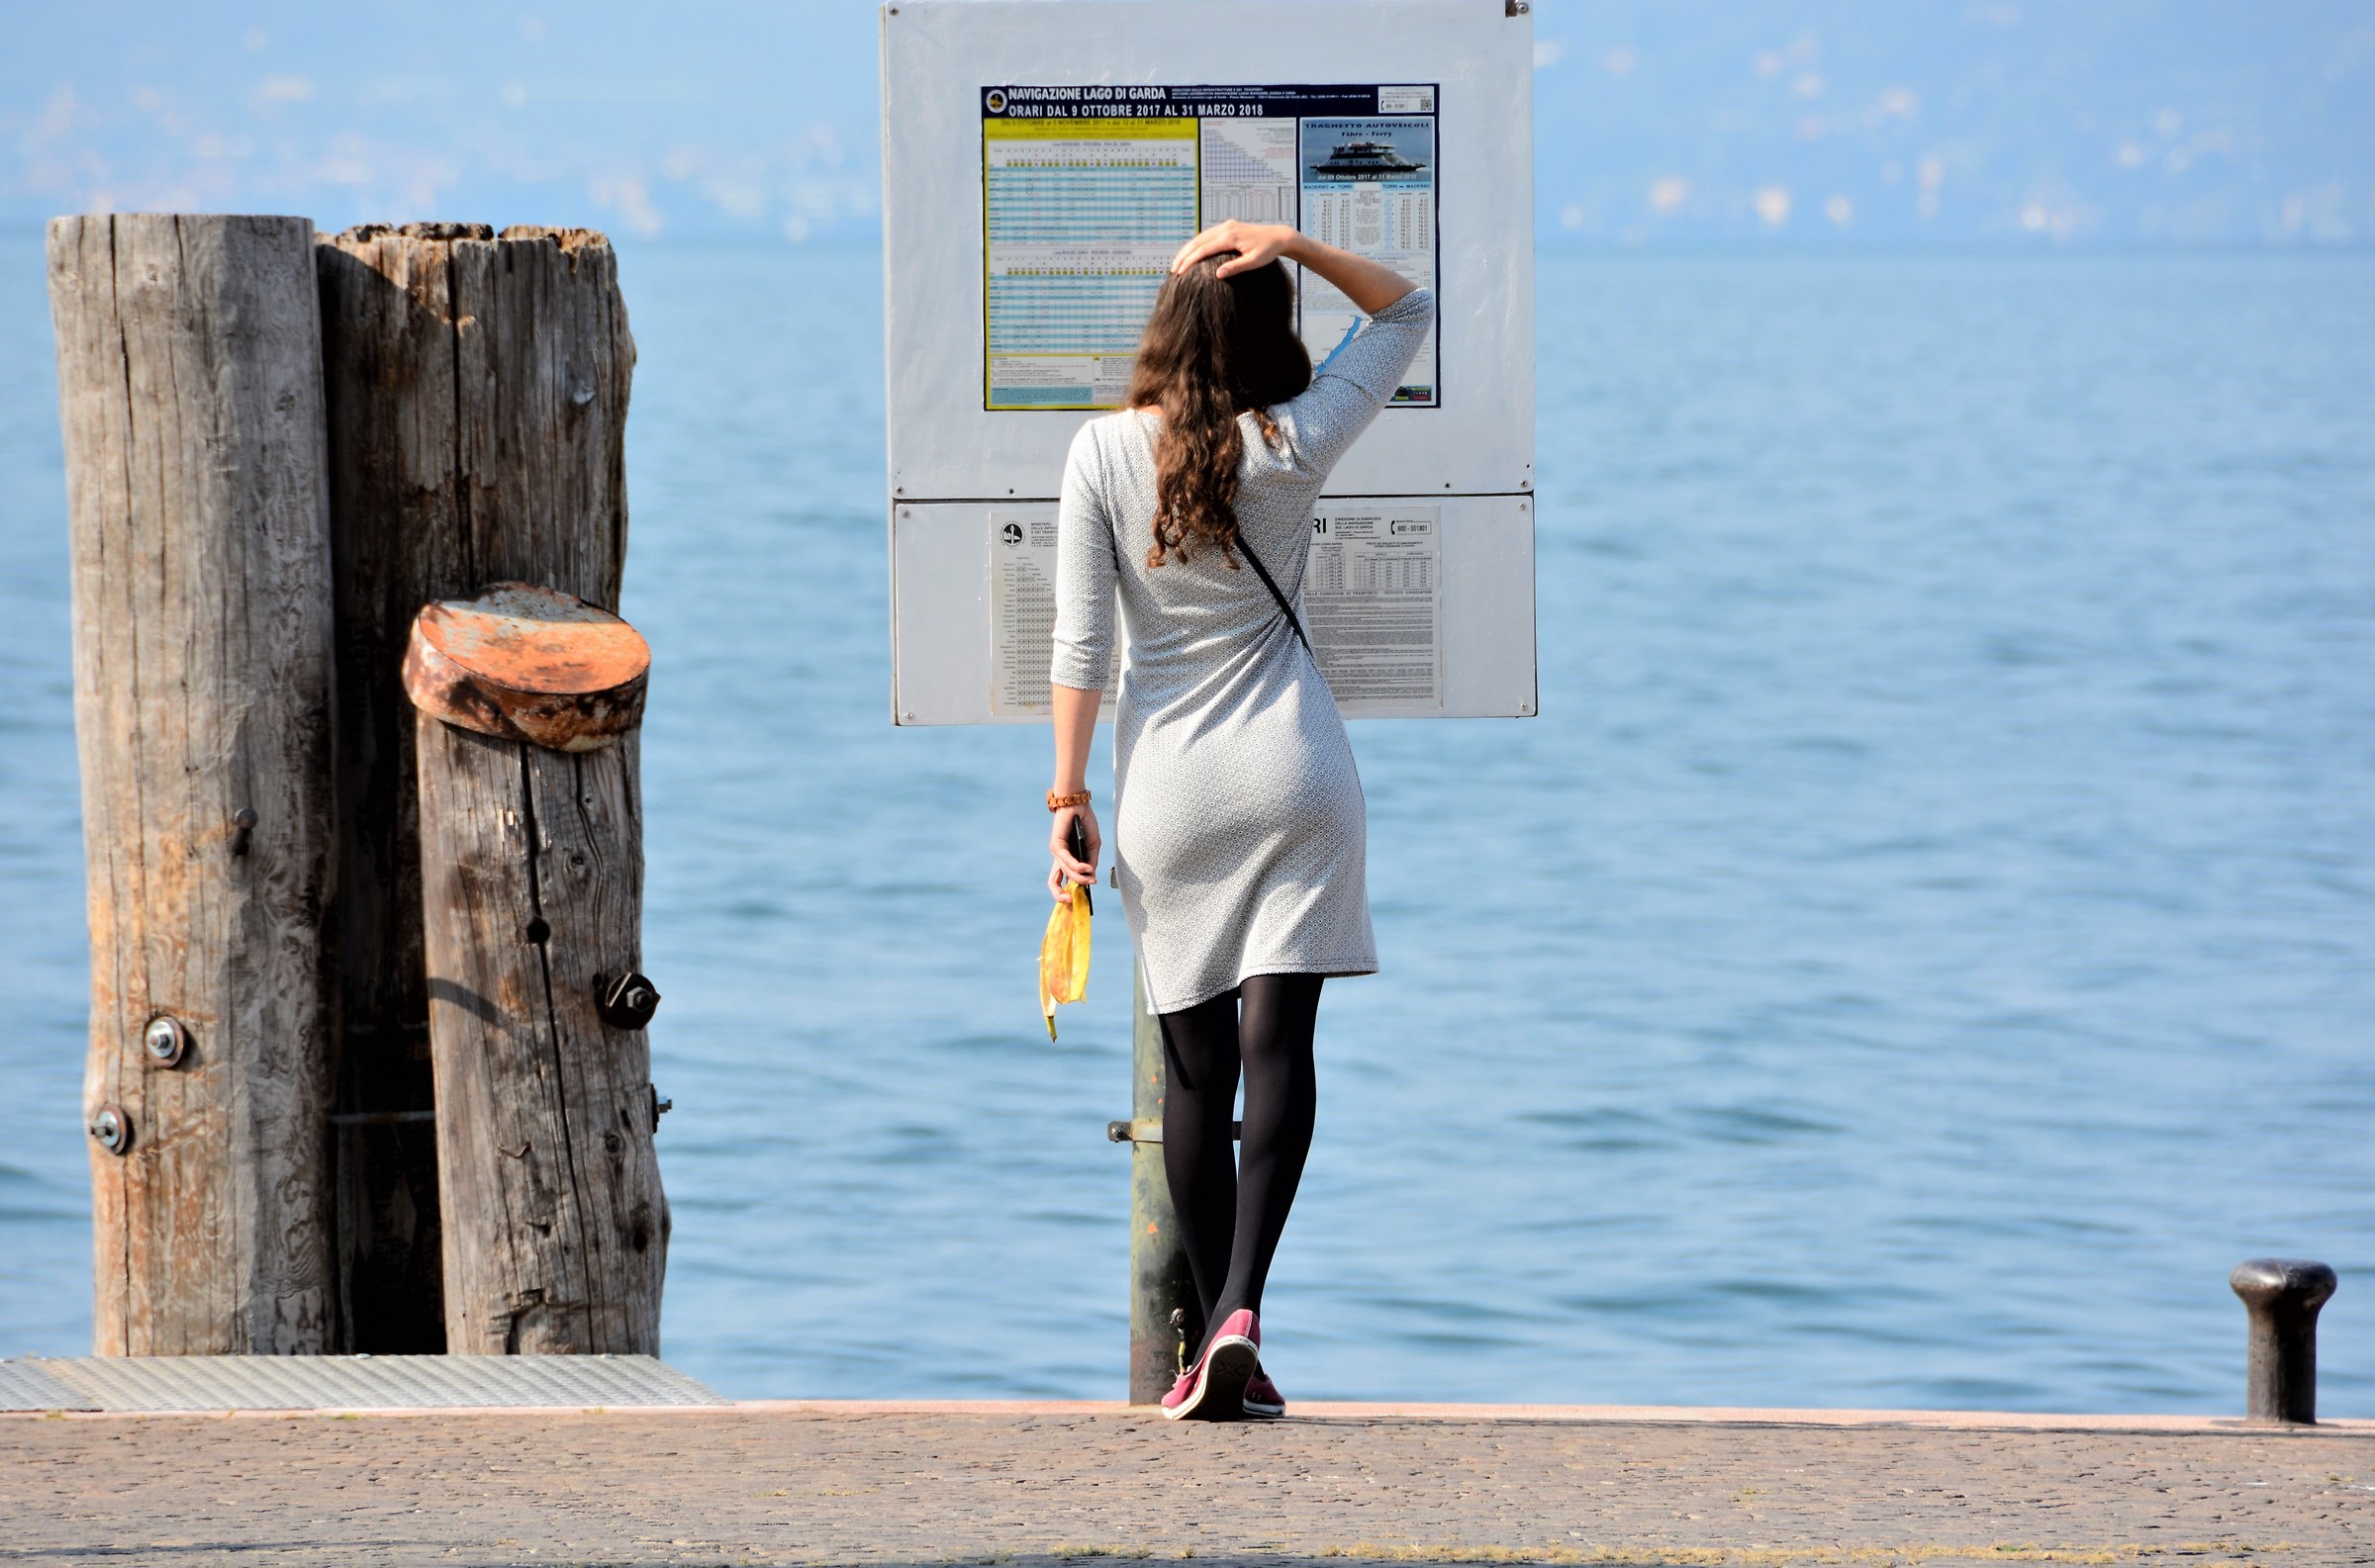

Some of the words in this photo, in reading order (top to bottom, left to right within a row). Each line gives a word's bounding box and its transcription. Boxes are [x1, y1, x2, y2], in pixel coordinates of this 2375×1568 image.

[1008, 88, 1081, 100] NAVIGAZIONE
[1084, 88, 1113, 100] LAGO
[1115, 88, 1126, 100] DI
[1129, 88, 1166, 100] GARDA
[1009, 105, 1042, 117] ORARI
[1047, 105, 1068, 117] DAL
[1072, 105, 1077, 117] 9
[1082, 105, 1132, 116] OTTOBRE
[1137, 105, 1160, 116] 2017
[1164, 104, 1178, 116] AL
[1182, 104, 1193, 116] 31
[1198, 104, 1235, 116] MARZO
[1239, 104, 1263, 116] 2018
[1313, 518, 1326, 533] RI
